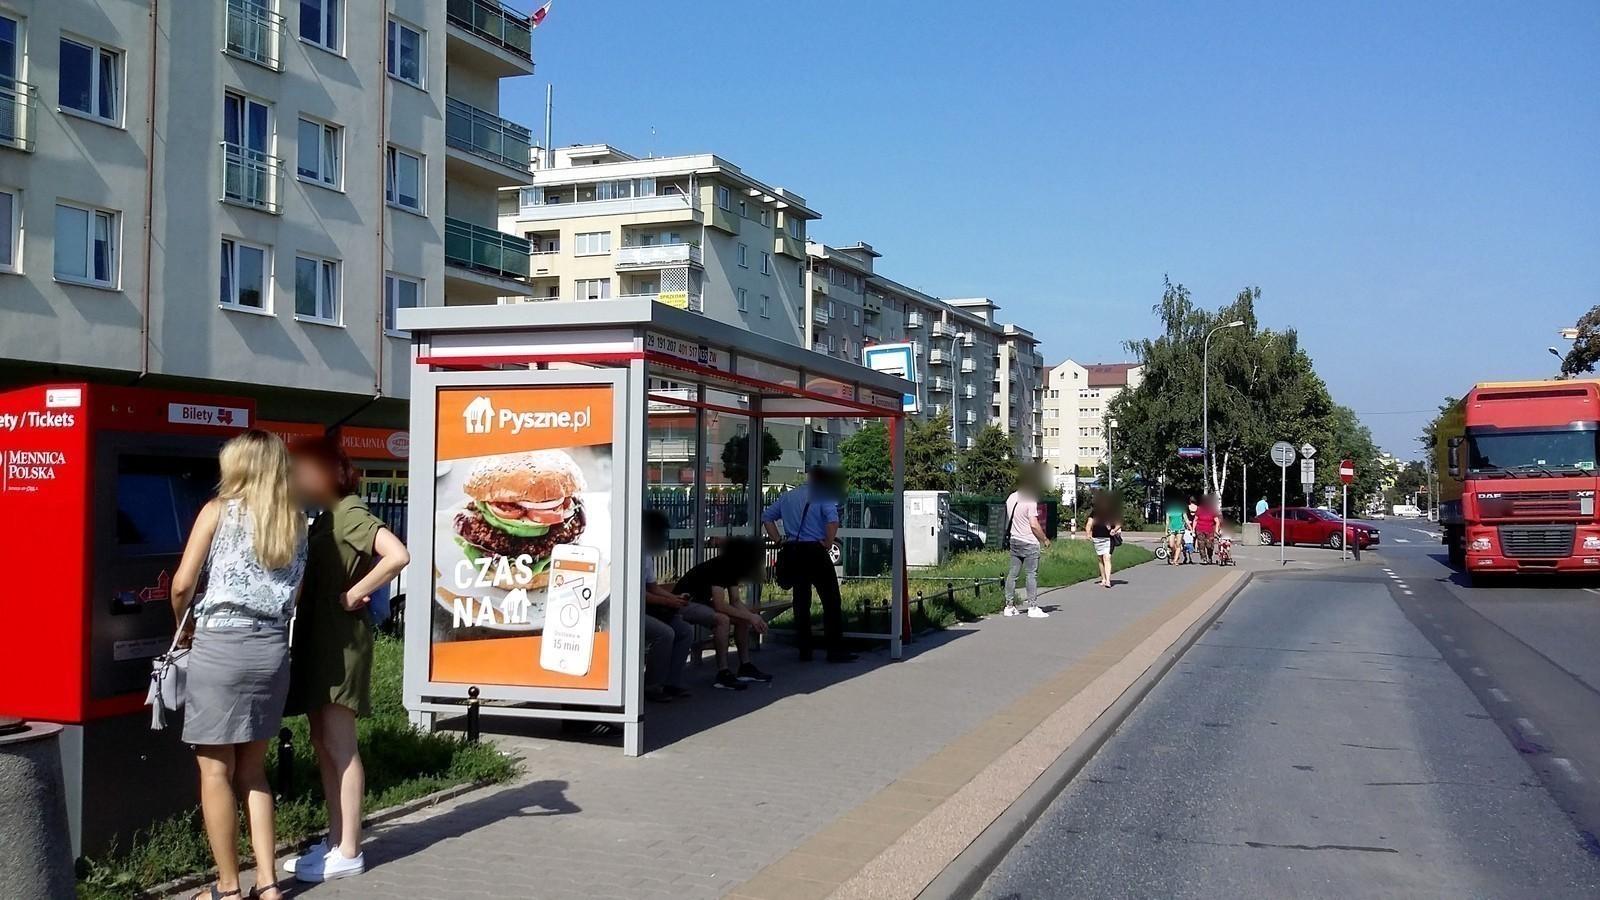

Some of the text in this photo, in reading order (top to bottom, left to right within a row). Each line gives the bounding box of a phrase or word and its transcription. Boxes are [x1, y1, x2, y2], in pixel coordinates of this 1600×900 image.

[648, 335, 654, 346] 29
[657, 337, 666, 349] 191
[667, 339, 676, 352] 207
[679, 343, 688, 355] 401
[689, 346, 698, 357] 517
[28, 411, 75, 427] Tickets
[182, 407, 213, 423] Bilety
[499, 406, 591, 435] Pyszne.pl
[342, 436, 386, 449] PIEKARNIA
[9, 450, 66, 464] MENNICA
[9, 465, 55, 479] POLSKA
[454, 554, 533, 589] CZAS
[452, 596, 496, 628] NA
[553, 639, 580, 652] 15 min
